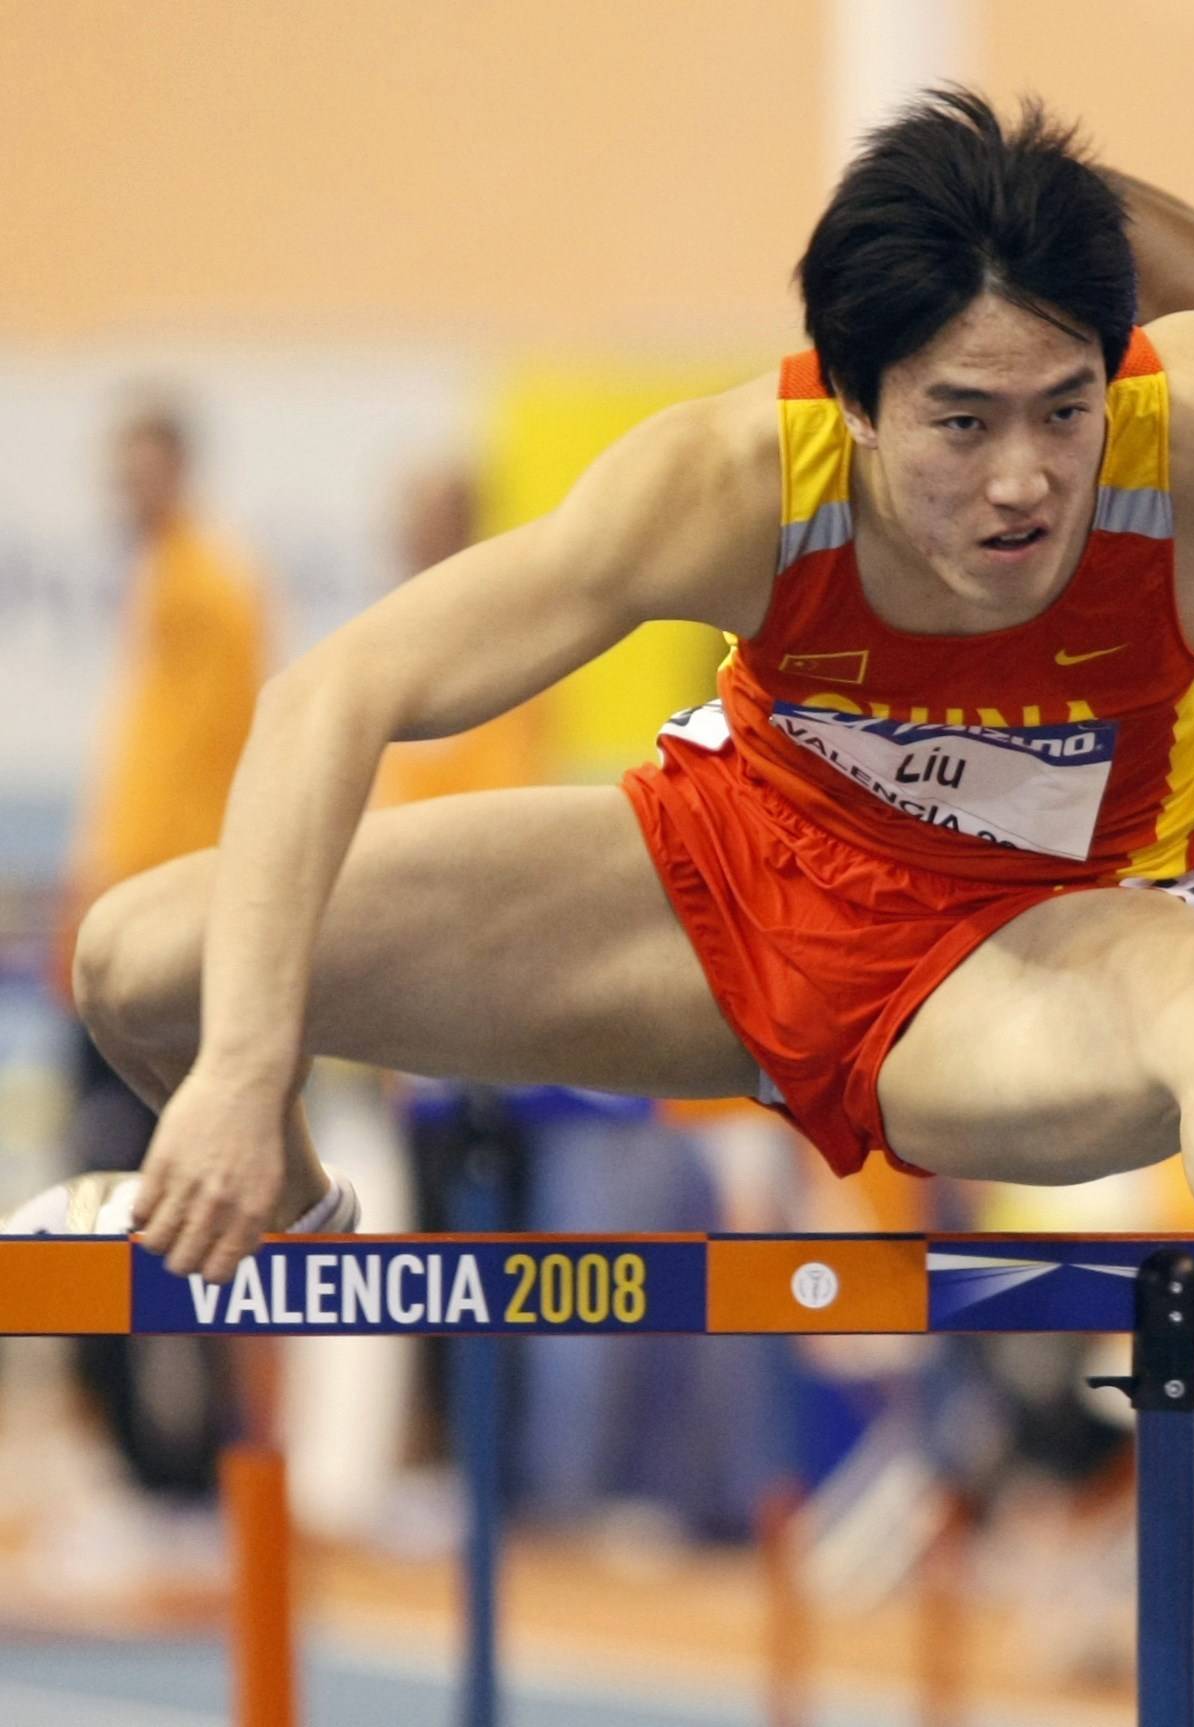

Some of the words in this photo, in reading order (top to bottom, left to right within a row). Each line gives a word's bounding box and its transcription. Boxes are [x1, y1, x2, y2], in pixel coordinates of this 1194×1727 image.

[896, 747, 966, 789] Liu
[189, 1254, 491, 1324] VALENCIA
[503, 1252, 647, 1324] 2008
